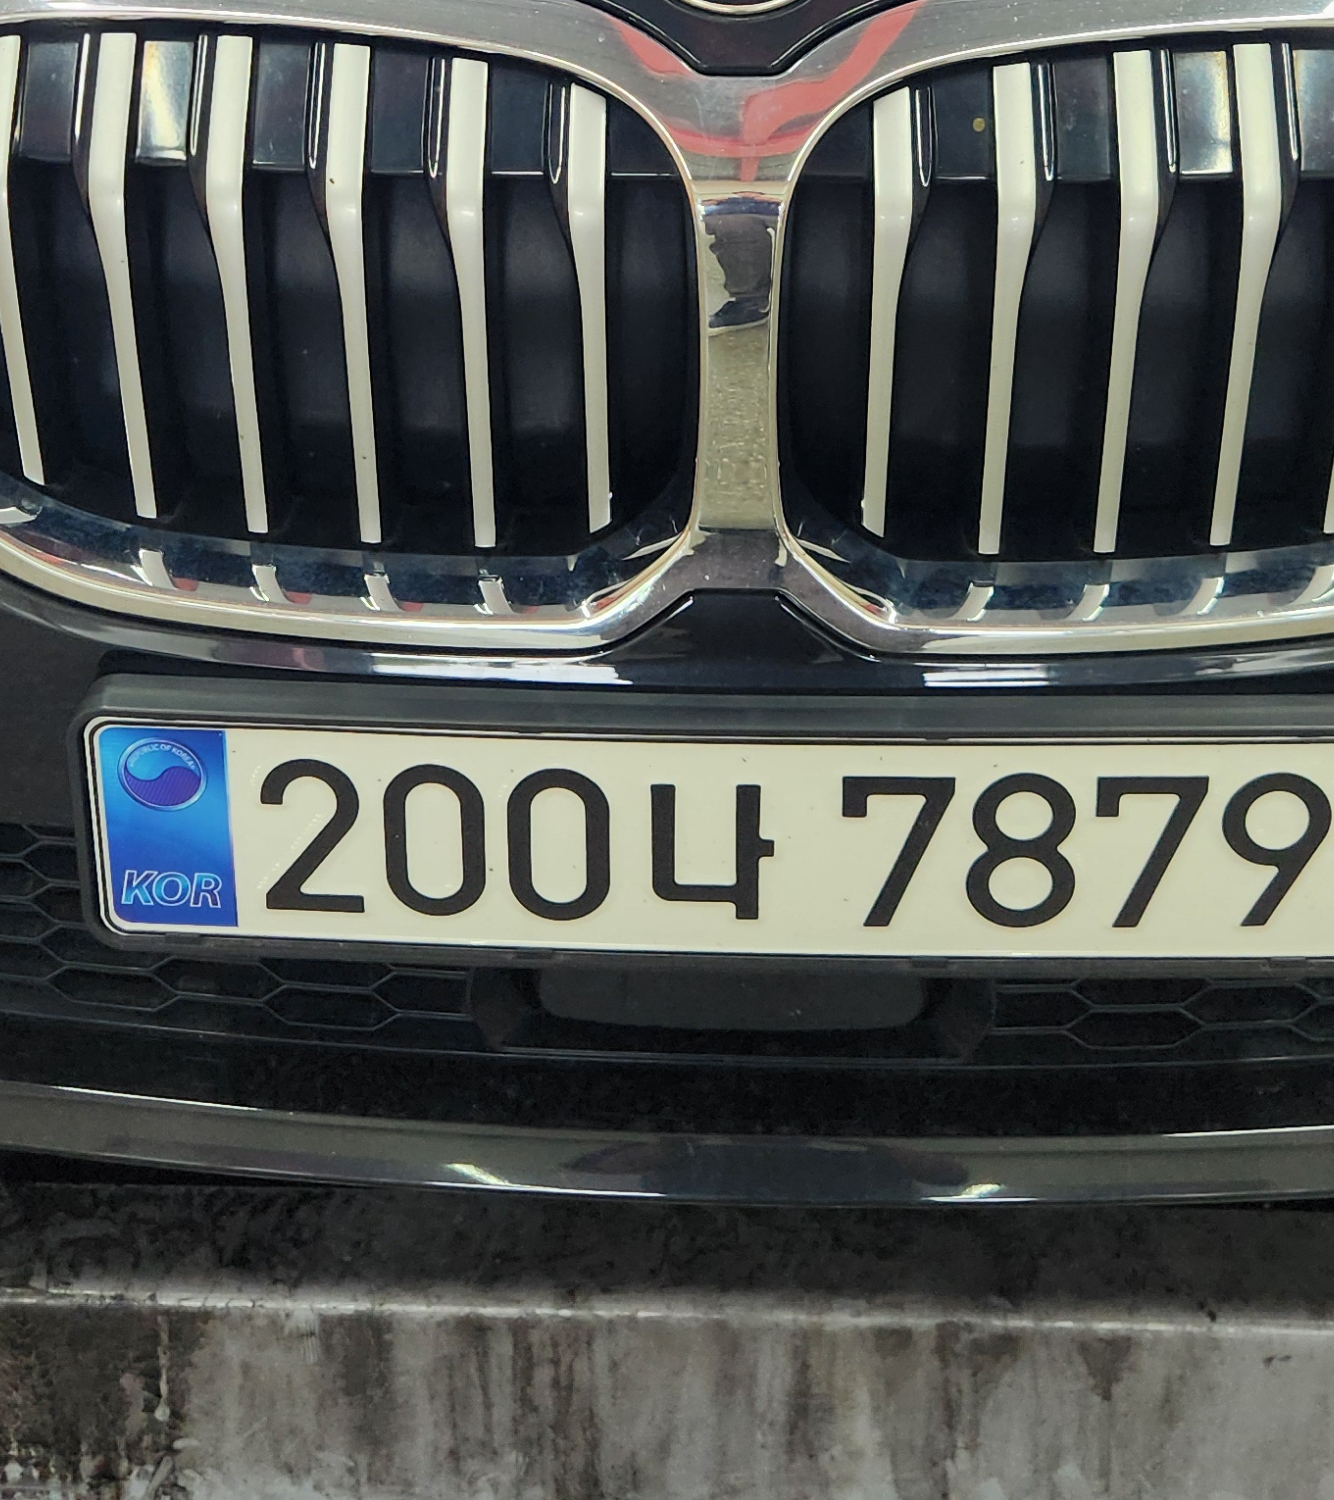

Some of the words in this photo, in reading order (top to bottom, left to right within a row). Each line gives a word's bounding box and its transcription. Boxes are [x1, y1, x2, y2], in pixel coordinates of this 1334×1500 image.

[160, 743, 172, 751] OF
[172, 746, 195, 766] KOREA
[258, 758, 777, 922] 200나
[840, 770, 1334, 930] 7879
[121, 869, 223, 909] KOR
